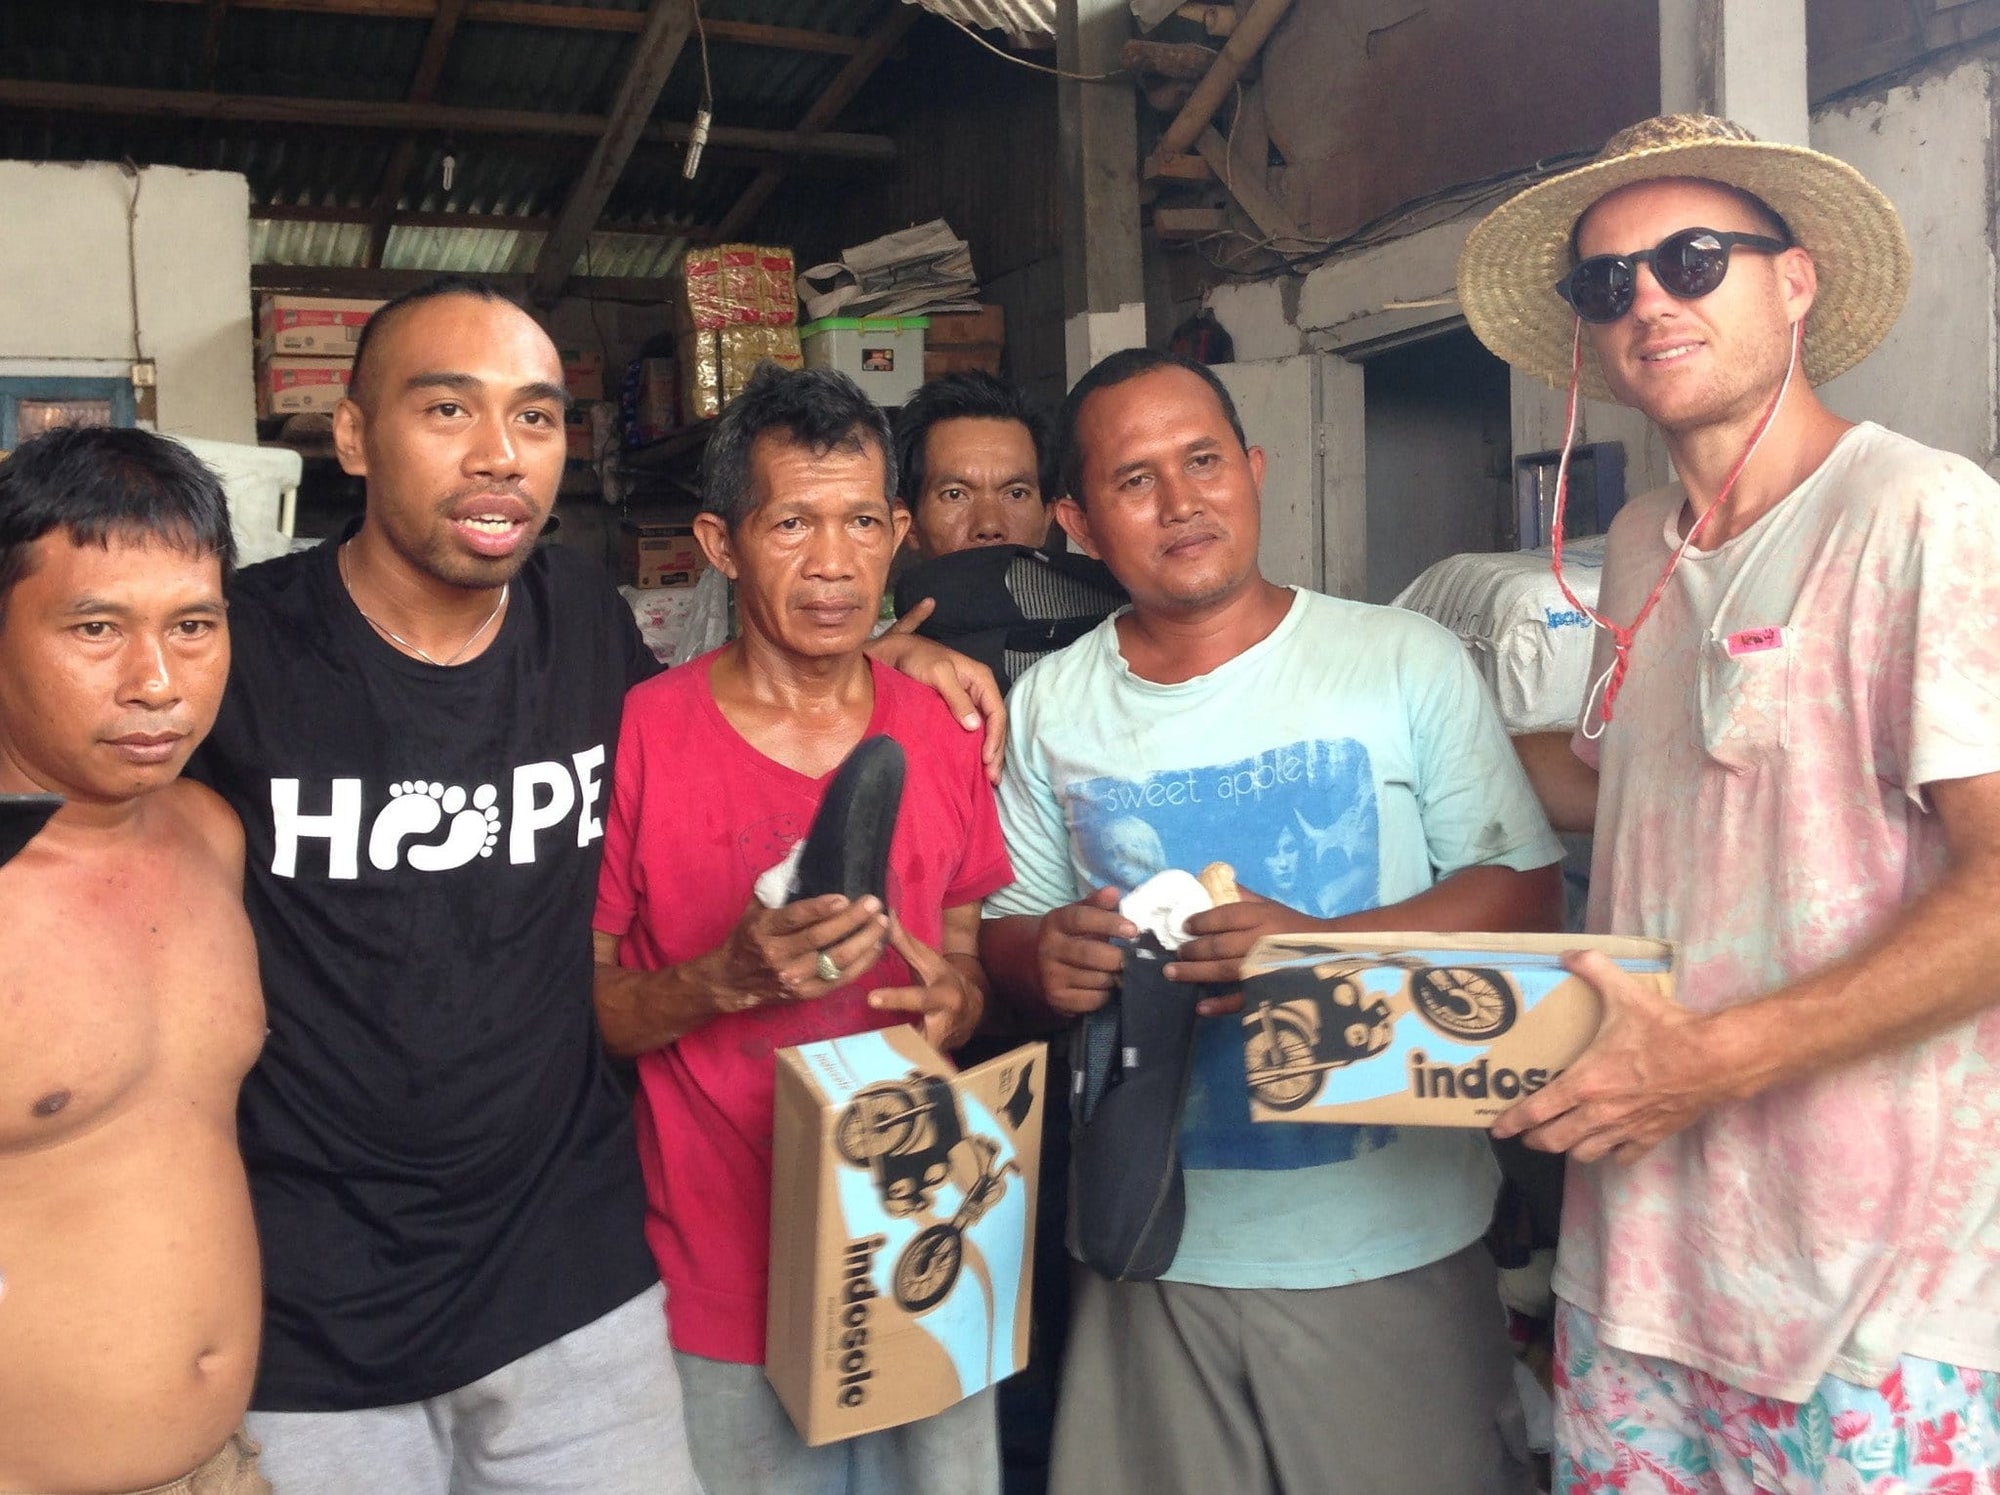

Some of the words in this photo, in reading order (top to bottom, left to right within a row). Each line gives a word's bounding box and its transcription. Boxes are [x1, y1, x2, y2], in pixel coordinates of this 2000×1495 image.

[270, 744, 605, 880] HOPE
[1104, 768, 1202, 812] sweet
[1217, 756, 1303, 806] apple
[1413, 1052, 1565, 1099] indos
[837, 1235, 885, 1409] indosole
